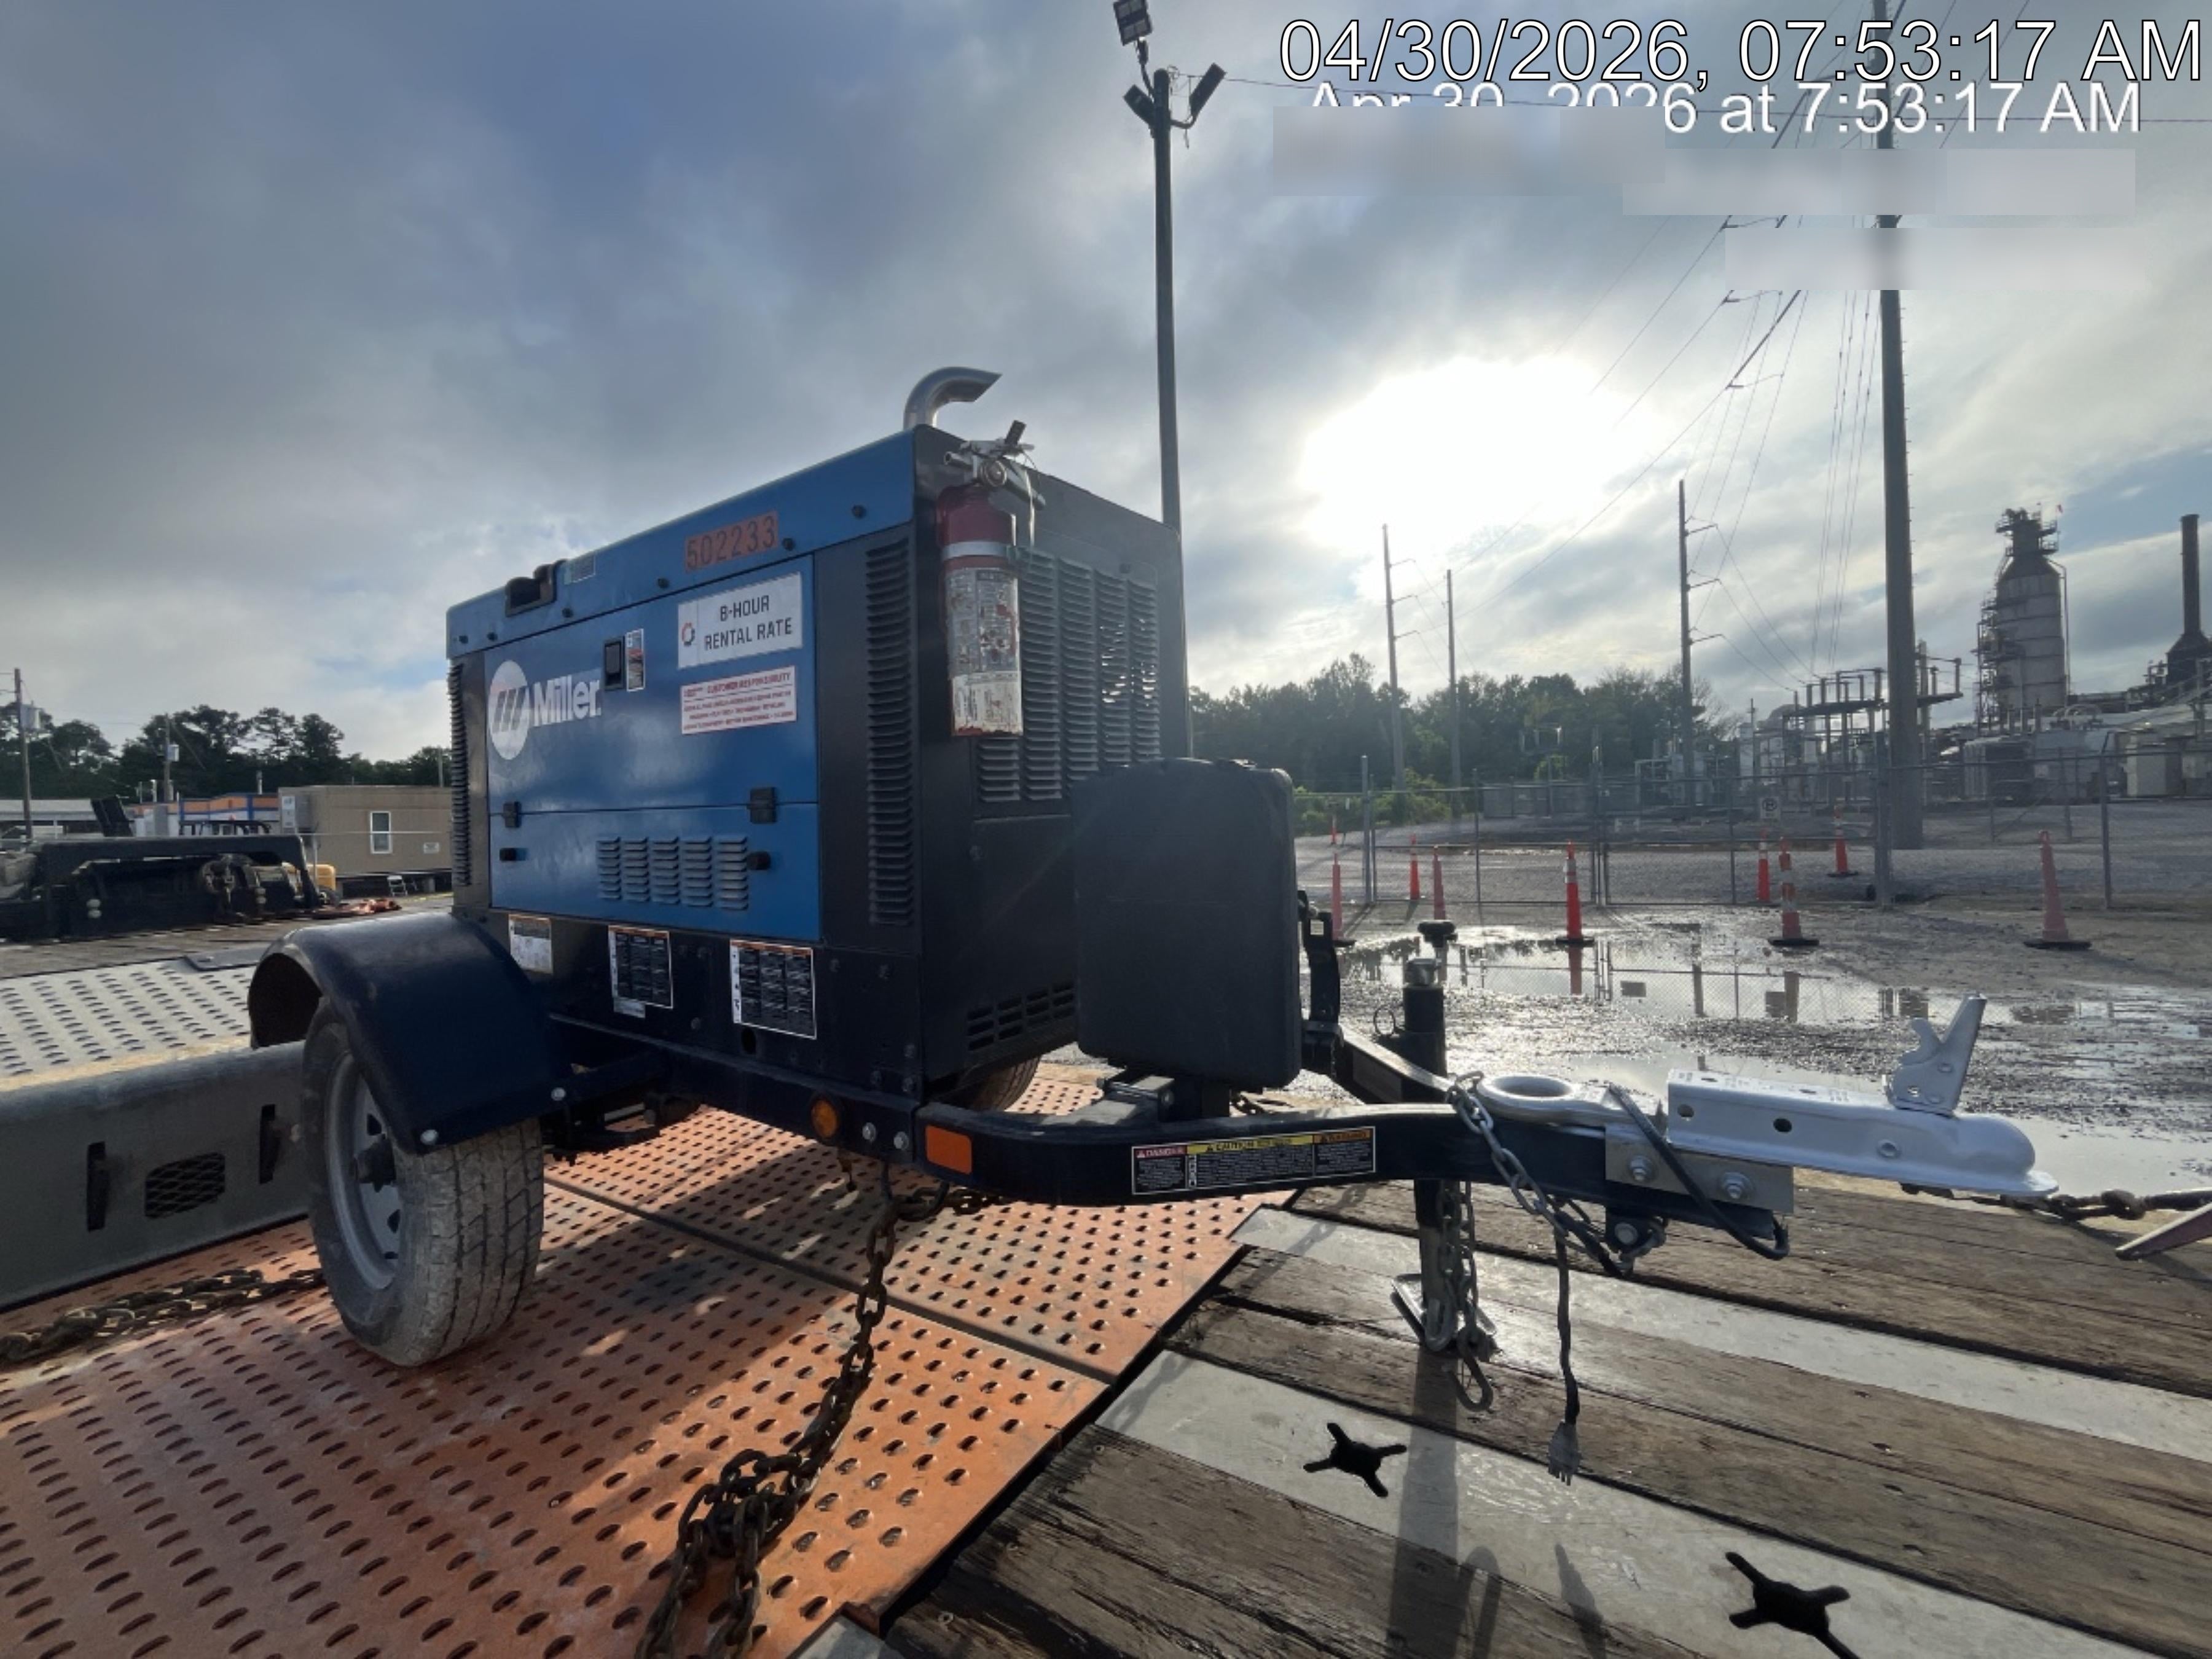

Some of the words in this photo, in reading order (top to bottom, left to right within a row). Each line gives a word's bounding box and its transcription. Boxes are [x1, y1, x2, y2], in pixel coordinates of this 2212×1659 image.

[686, 515, 775, 570] 502233
[704, 627, 753, 651] RENTAL
[756, 617, 793, 641] RATE
[533, 675, 600, 728] Miller
